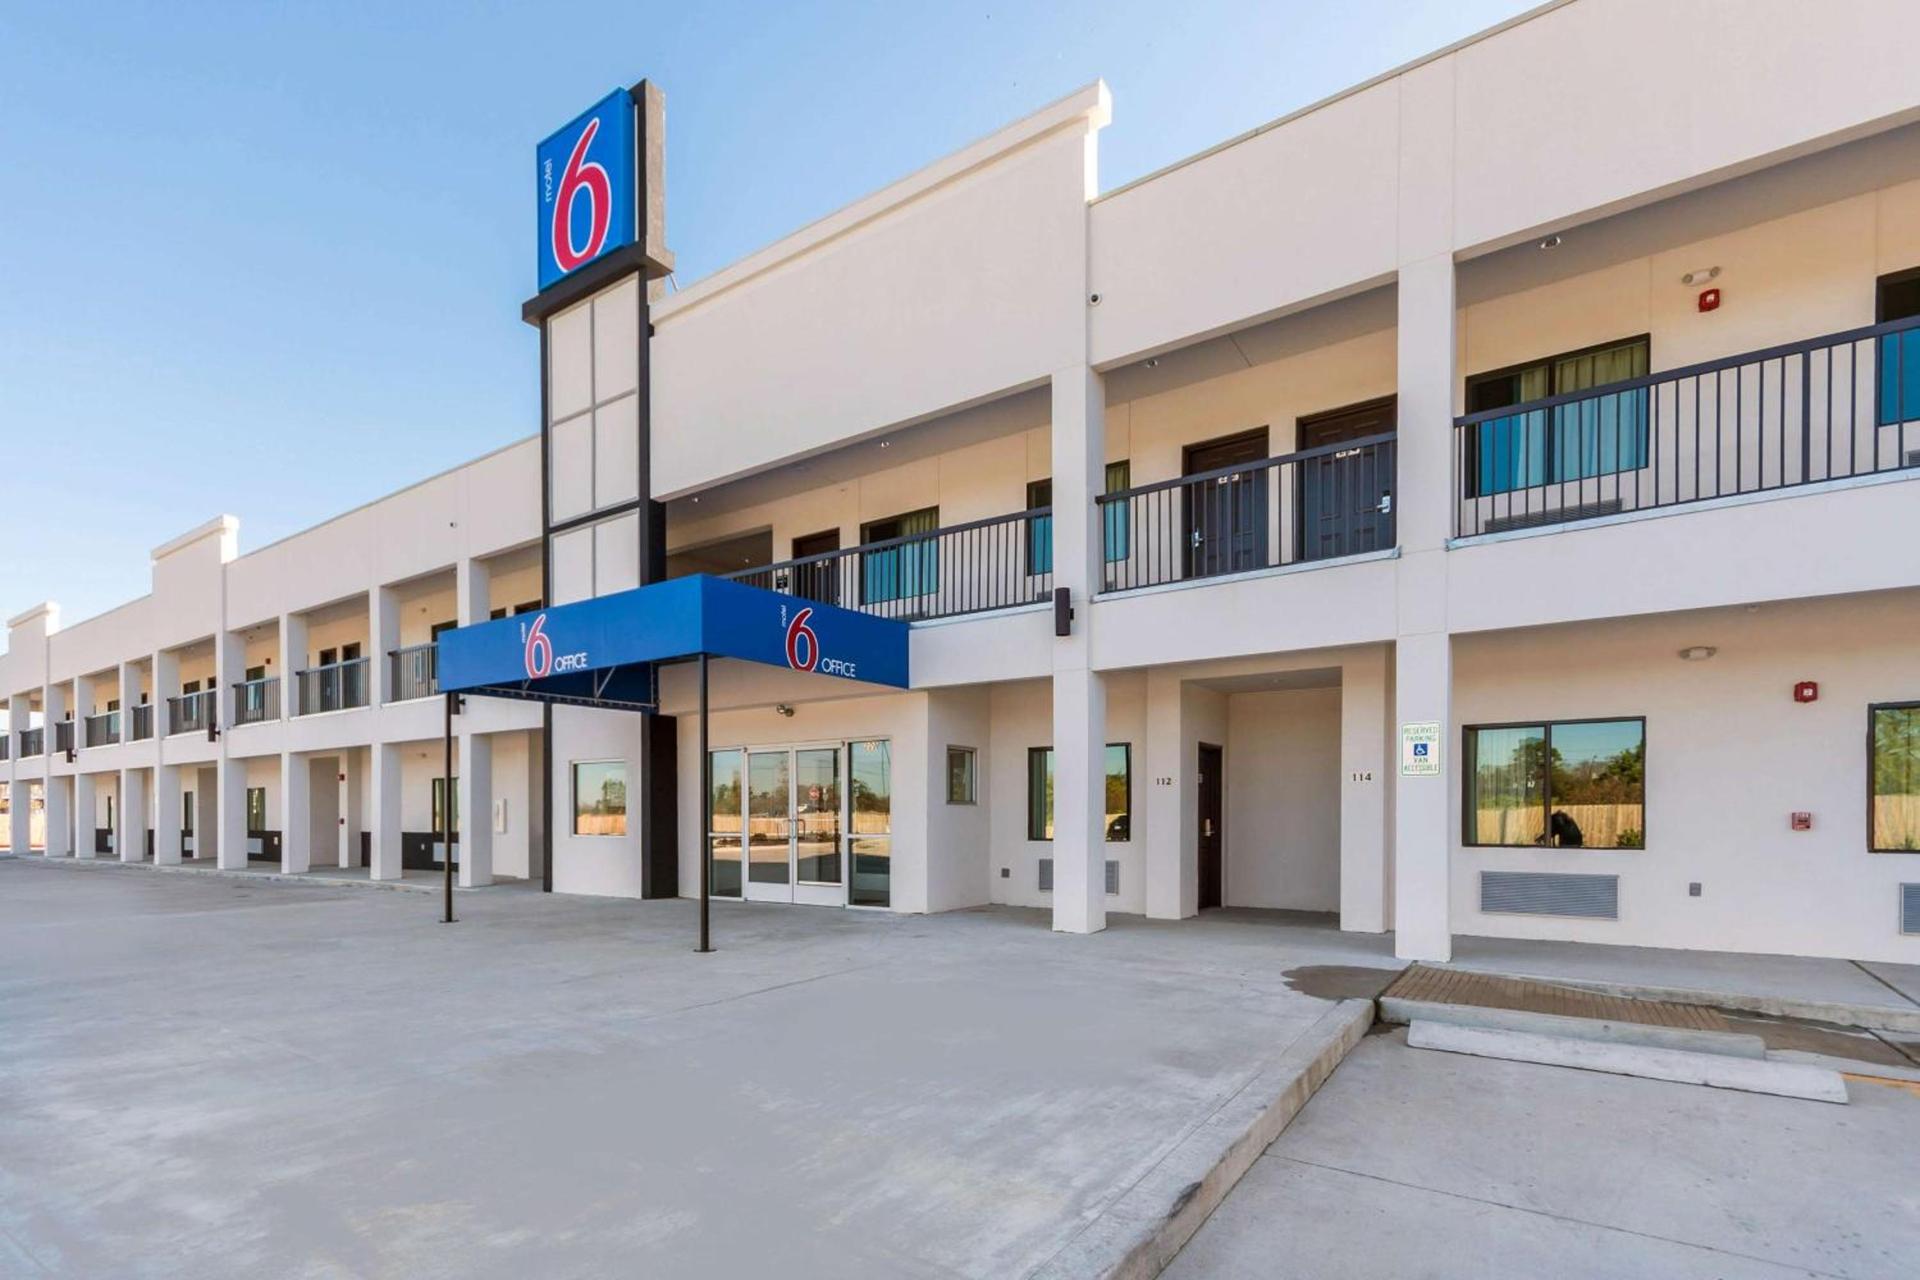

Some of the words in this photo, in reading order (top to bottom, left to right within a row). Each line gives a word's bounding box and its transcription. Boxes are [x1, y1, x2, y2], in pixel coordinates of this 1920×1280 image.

[553, 117, 612, 273] 6
[525, 613, 552, 679] 6
[554, 652, 588, 672] OFFICE
[785, 607, 819, 673] 6
[821, 657, 856, 678] OFFICE
[1156, 777, 1172, 786] 112
[1352, 772, 1372, 782] 114
